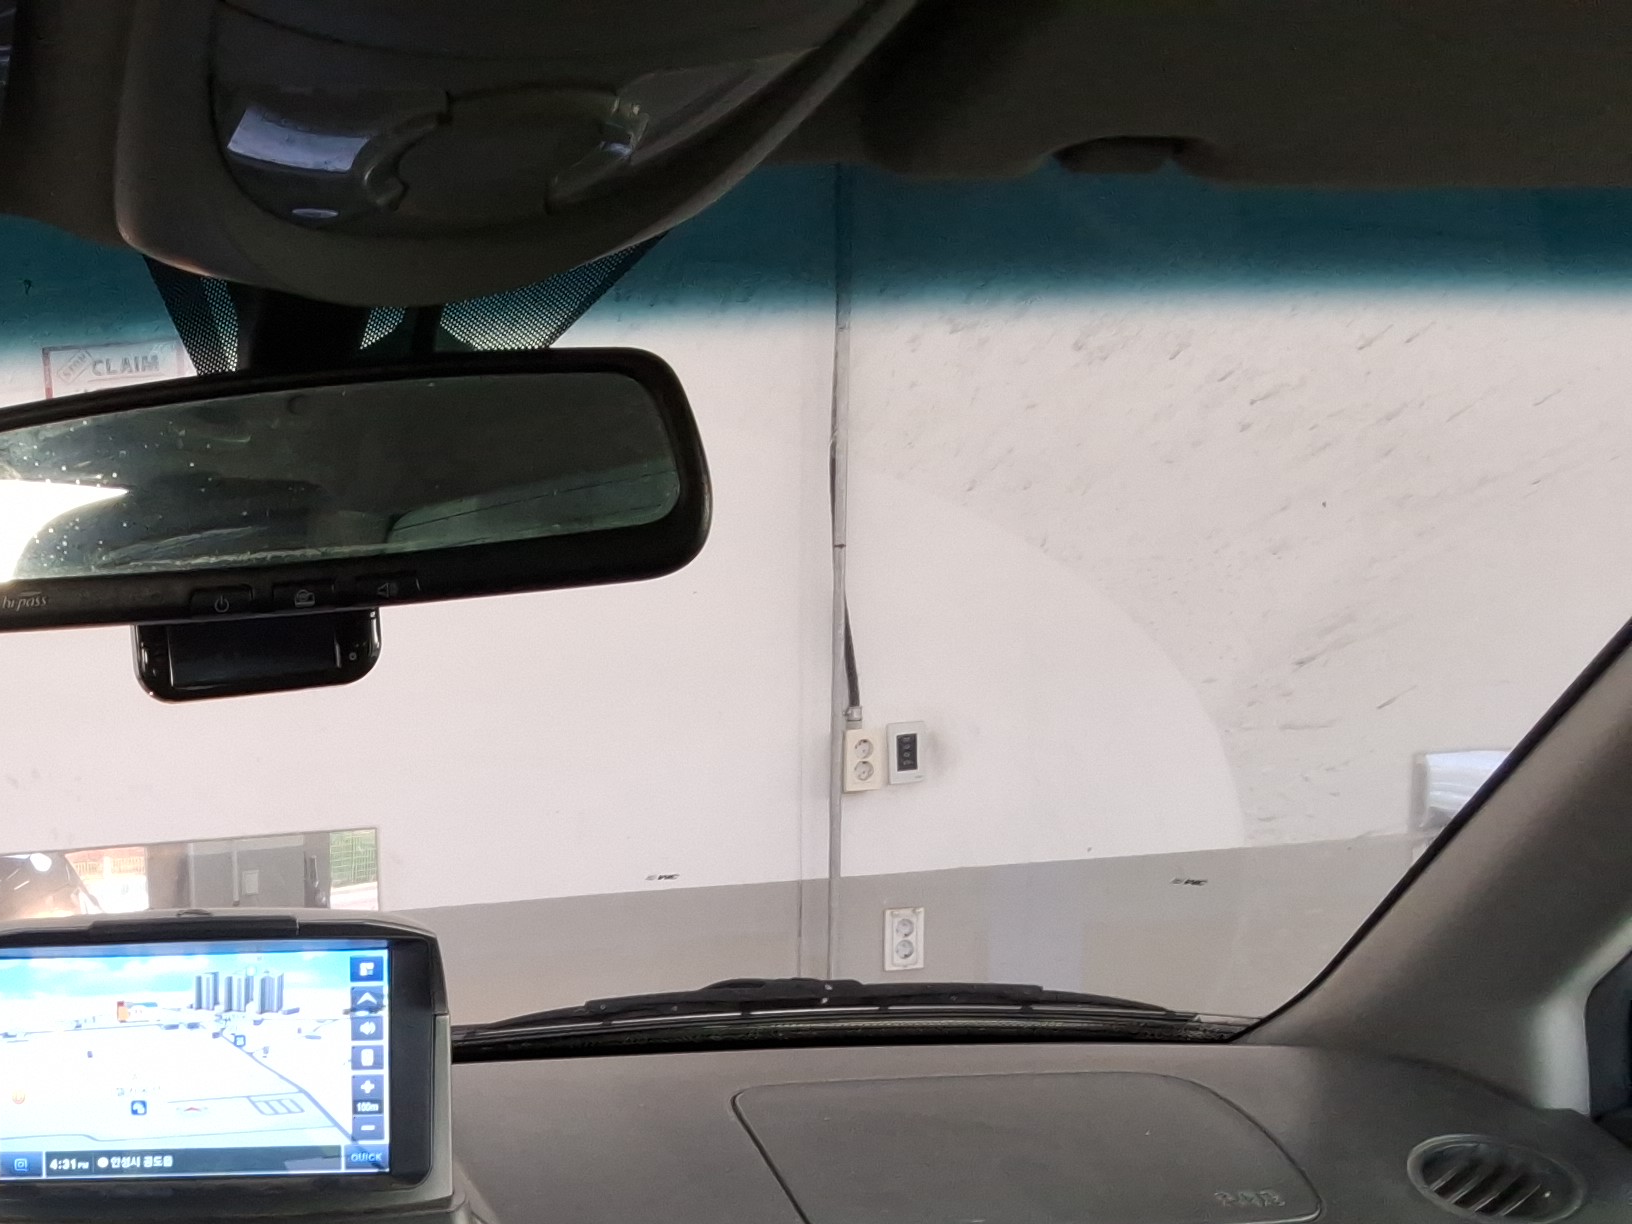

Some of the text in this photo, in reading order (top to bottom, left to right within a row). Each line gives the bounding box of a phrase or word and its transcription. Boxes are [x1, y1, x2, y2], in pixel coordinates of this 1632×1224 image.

[92, 355, 159, 376] CLAIM
[350, 1152, 383, 1162] QUICK
[49, 1158, 77, 1170] 4:31
